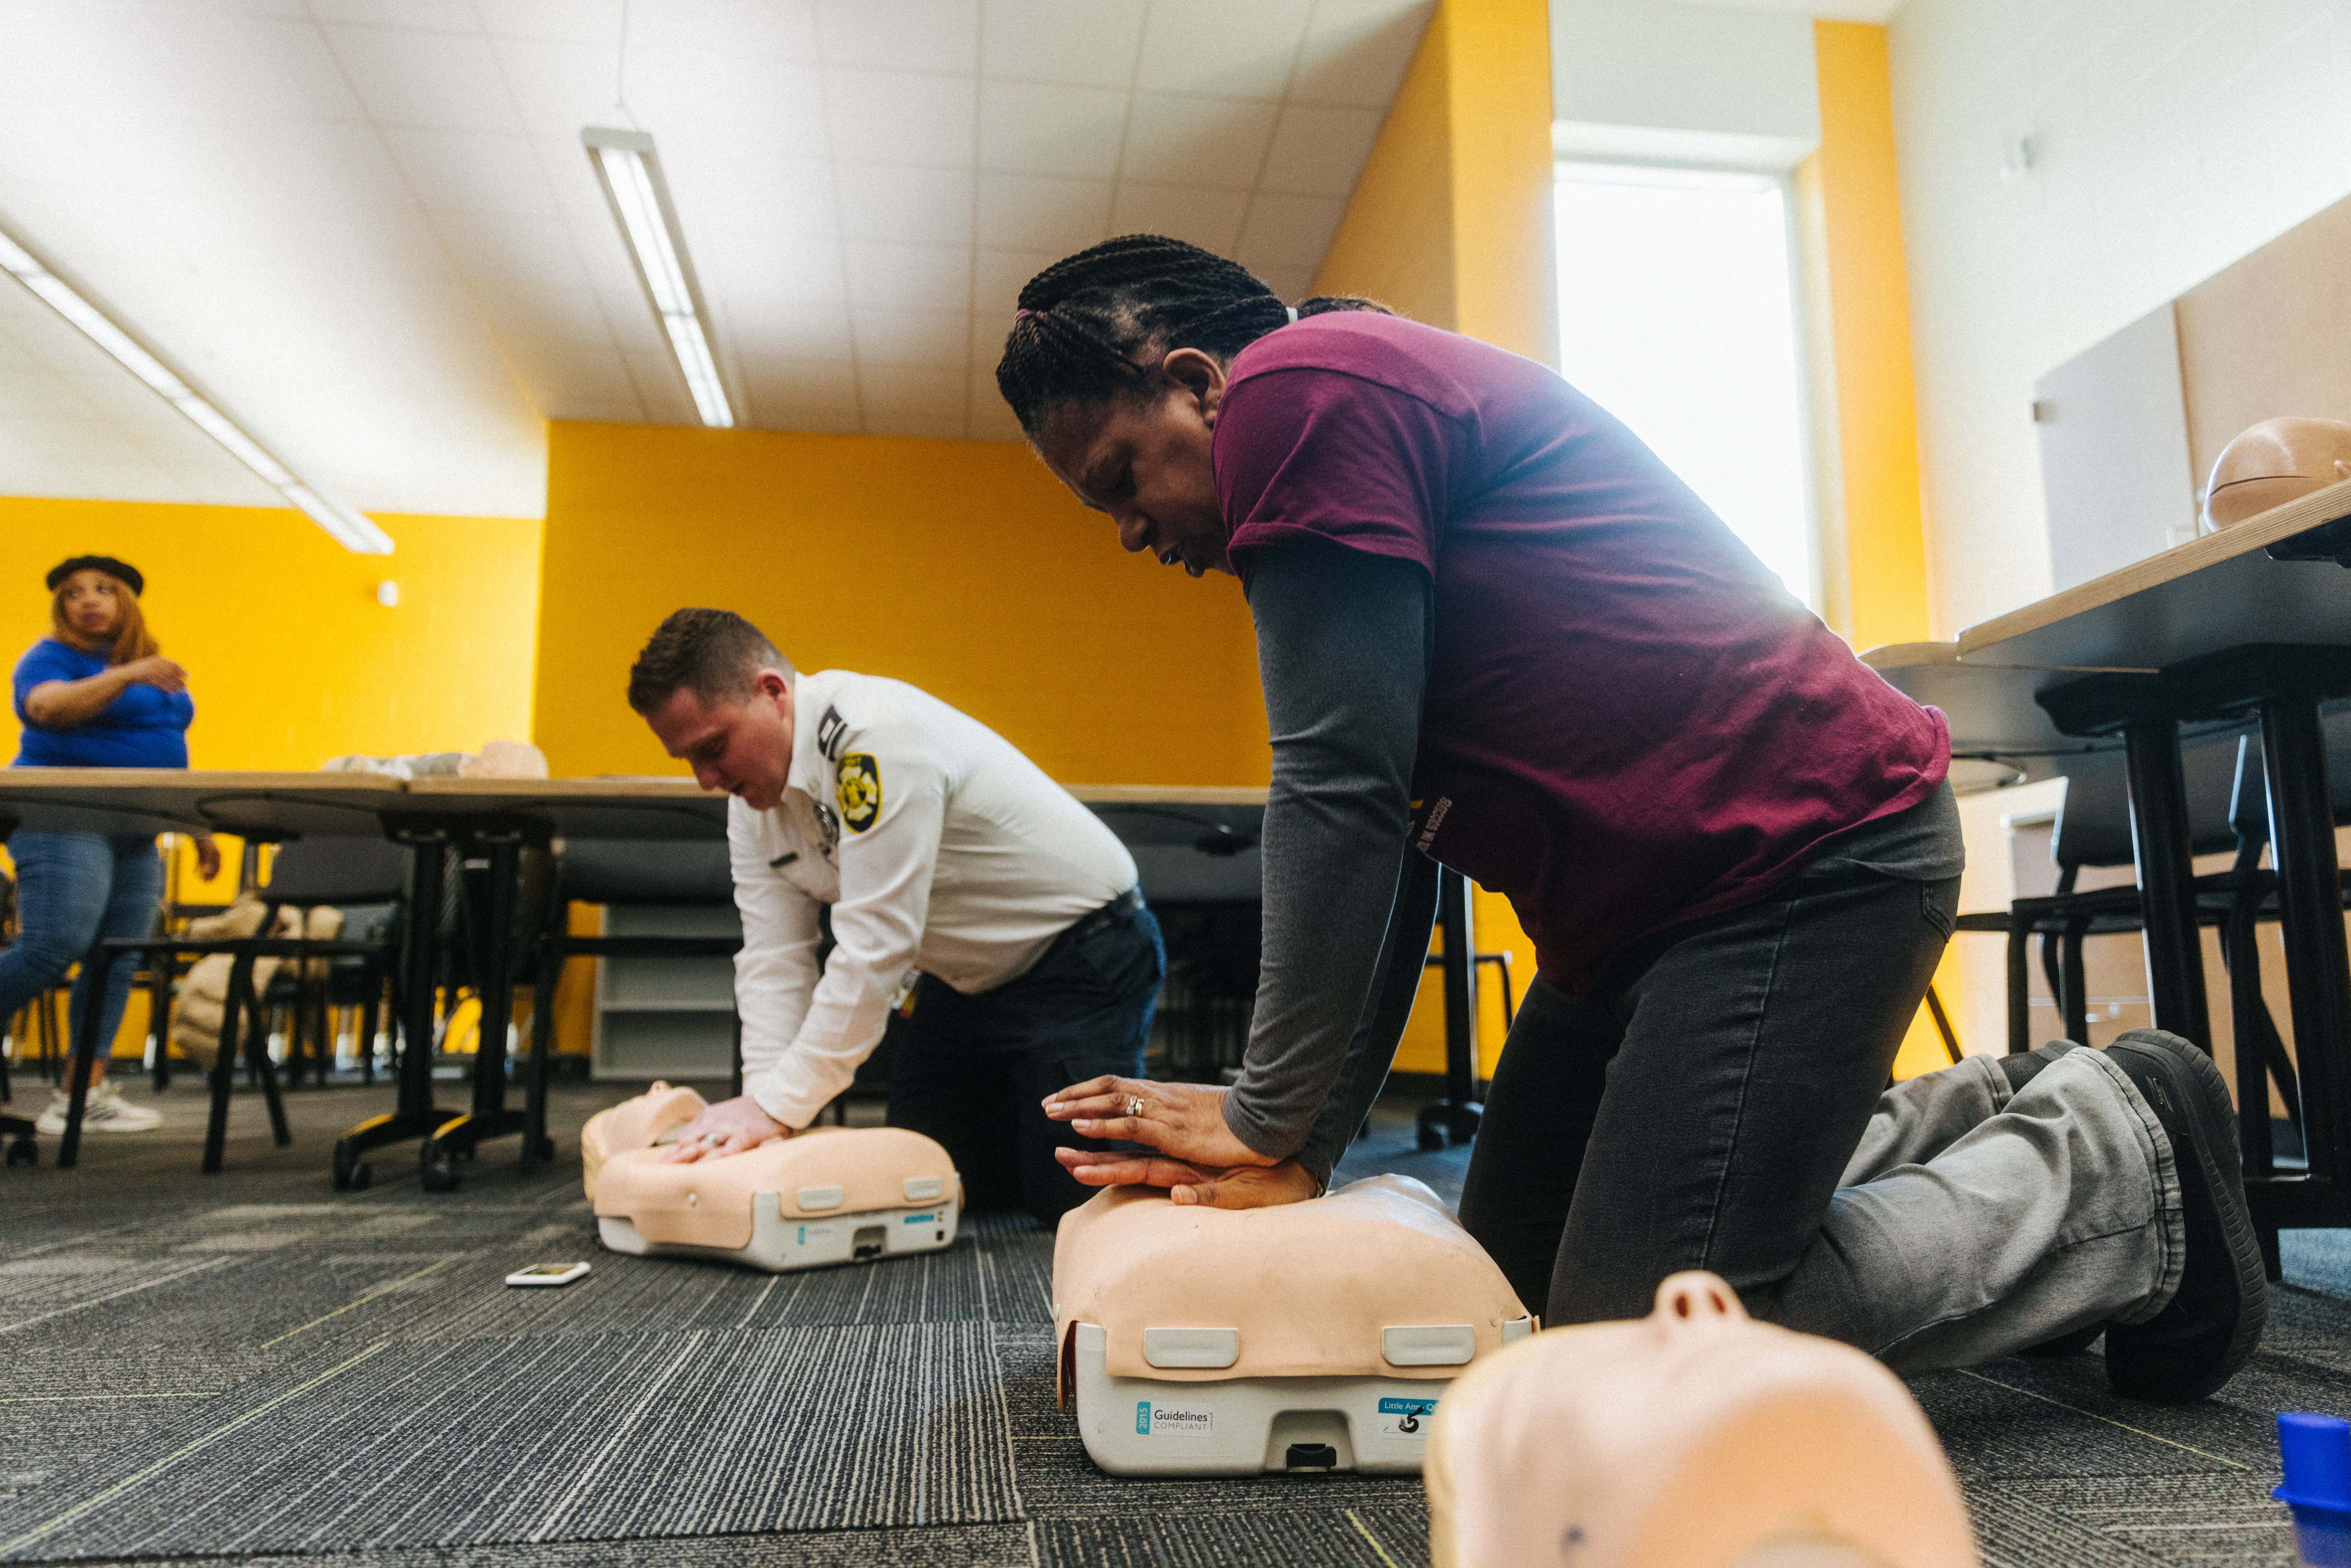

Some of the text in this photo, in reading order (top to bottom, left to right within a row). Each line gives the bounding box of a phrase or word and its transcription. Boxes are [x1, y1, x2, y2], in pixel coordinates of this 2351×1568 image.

[1385, 1401, 1403, 1410] Little
[1139, 1408, 1147, 1429] 2015
[1154, 1410, 1208, 1422] Guidelines
[1154, 1422, 1207, 1430] COMPLIANT
